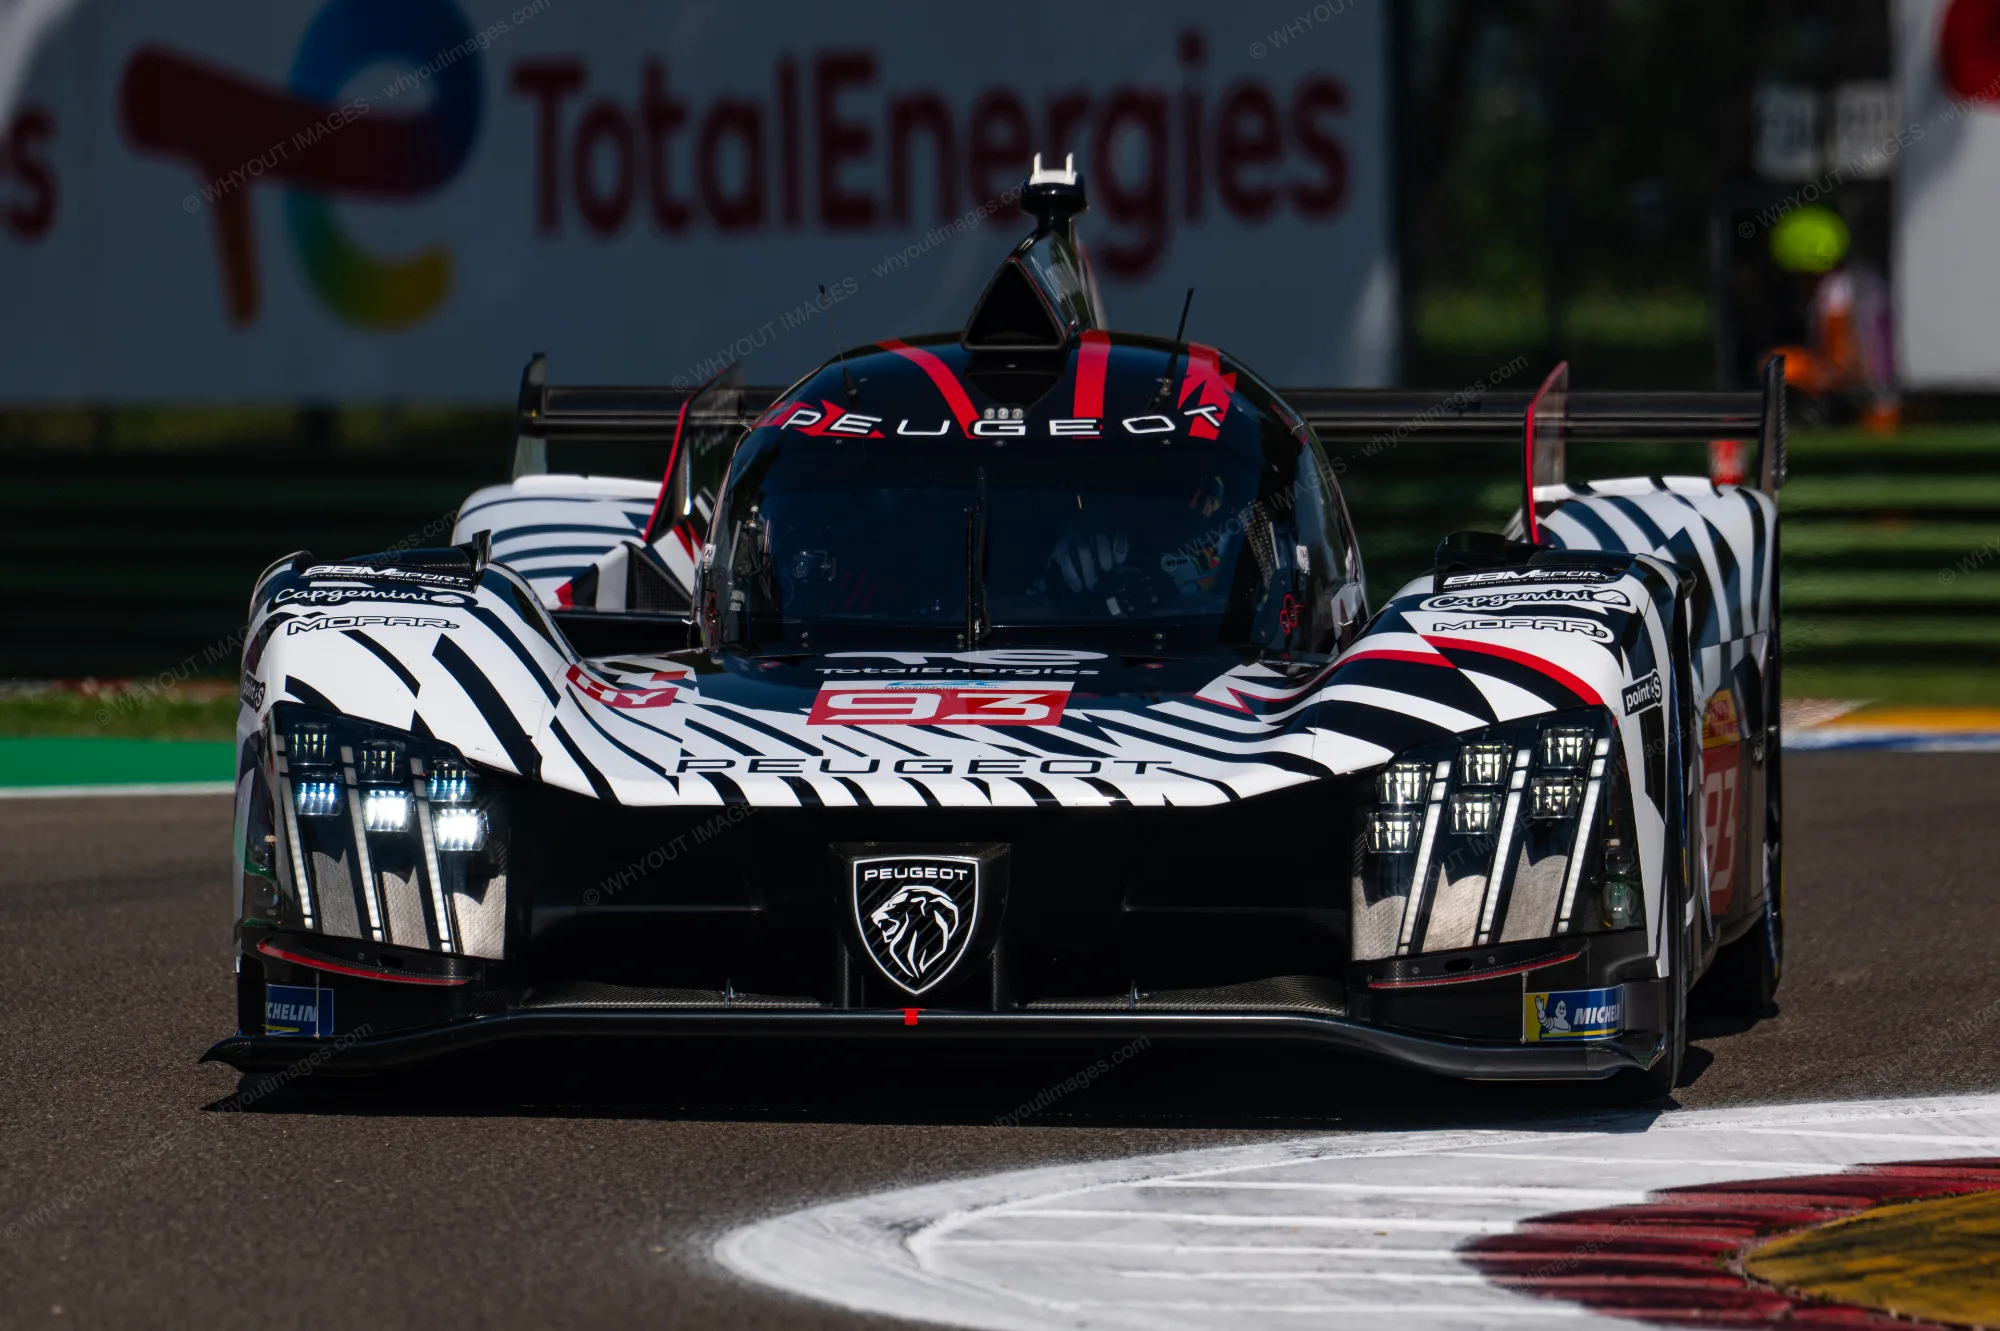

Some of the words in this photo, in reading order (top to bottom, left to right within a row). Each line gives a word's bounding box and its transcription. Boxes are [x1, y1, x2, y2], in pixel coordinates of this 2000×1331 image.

[508, 28, 1352, 282] TotalEnergies
[780, 408, 1223, 437] PEUGEOT
[274, 588, 428, 603] Capgemini
[1432, 589, 1591, 607] Capgemini
[815, 667, 1100, 676] TotalEnergies
[824, 692, 1053, 721] 93
[676, 758, 1172, 774] PEUGEOT
[864, 867, 969, 881] PEUGEOT
[265, 1002, 317, 1022] CHELIN
